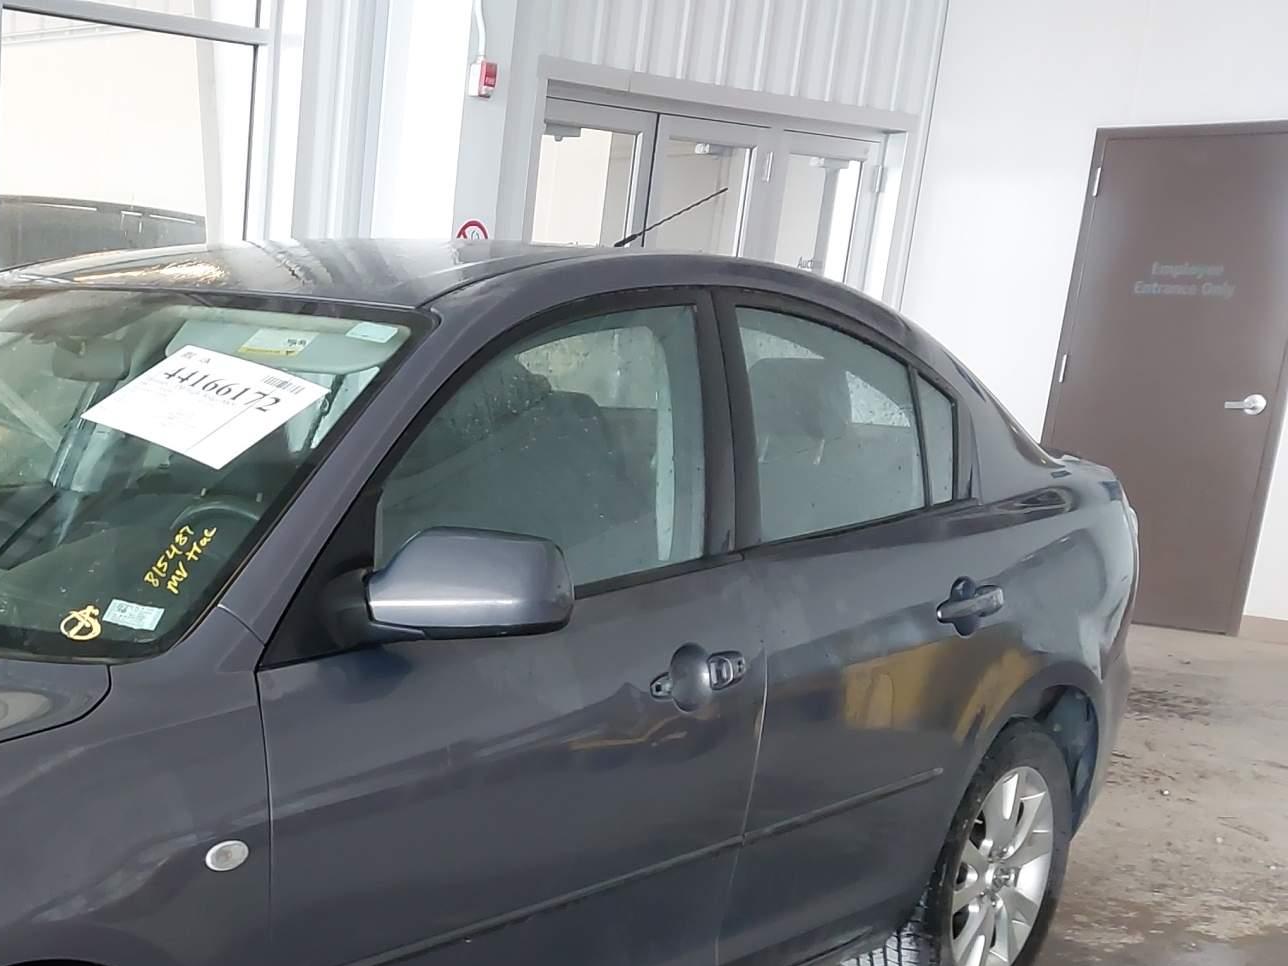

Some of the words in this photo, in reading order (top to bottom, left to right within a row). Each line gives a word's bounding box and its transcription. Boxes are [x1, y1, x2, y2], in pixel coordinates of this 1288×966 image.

[1151, 261, 1224, 278] Employee
[1134, 280, 1198, 295] Entrance
[1201, 281, 1236, 299] Only
[164, 367, 281, 412] 44166172
[144, 525, 194, 587] 815487
